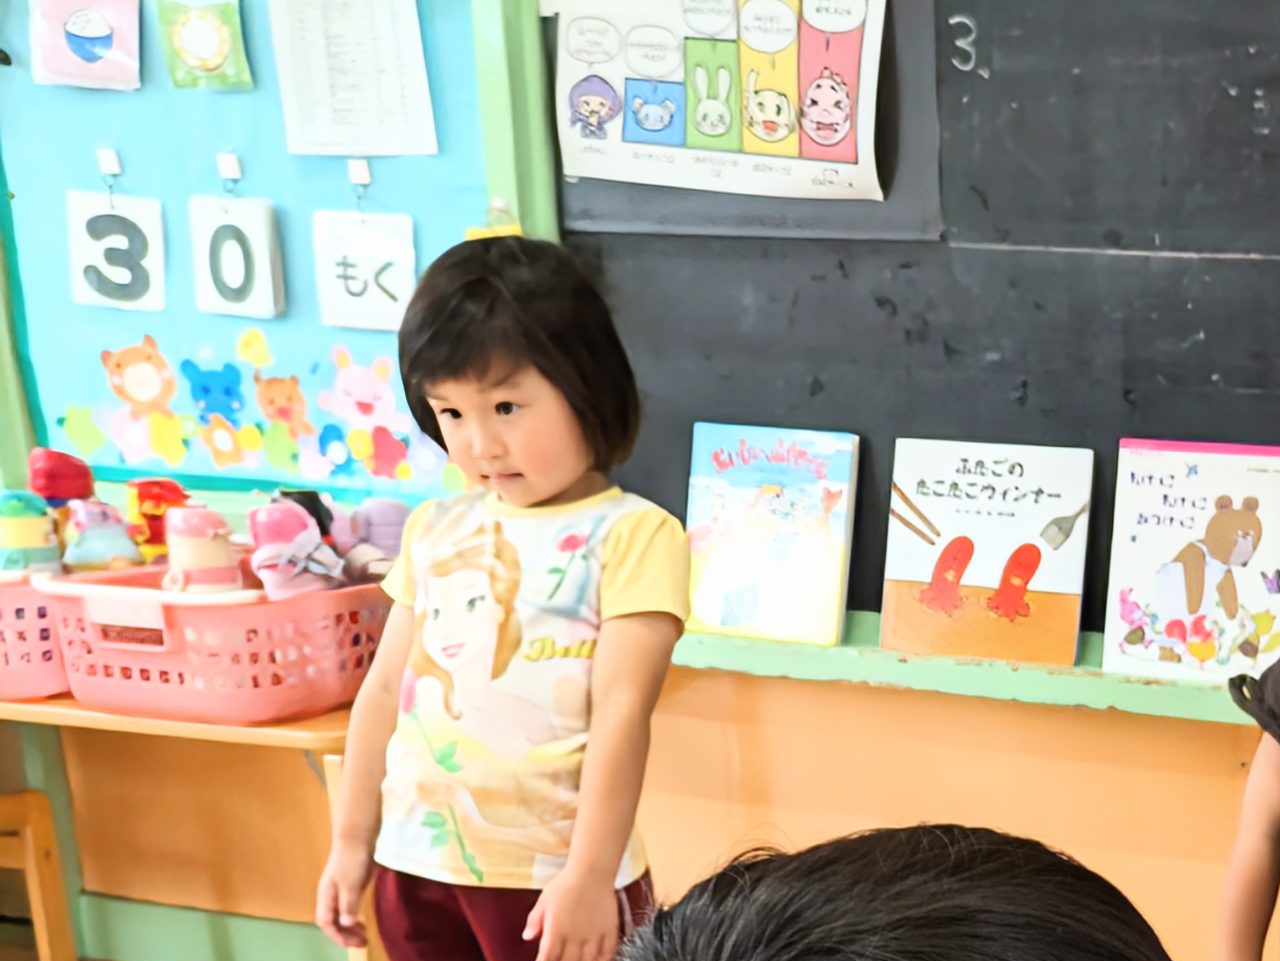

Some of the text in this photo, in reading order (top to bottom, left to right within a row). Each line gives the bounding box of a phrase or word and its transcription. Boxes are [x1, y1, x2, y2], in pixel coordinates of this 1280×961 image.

[83, 214, 151, 302] 3
[209, 224, 255, 304] 0
[335, 255, 398, 303] もく
[916, 478, 1062, 504] たこたこウィンナー
[955, 457, 1025, 478] ふたごの
